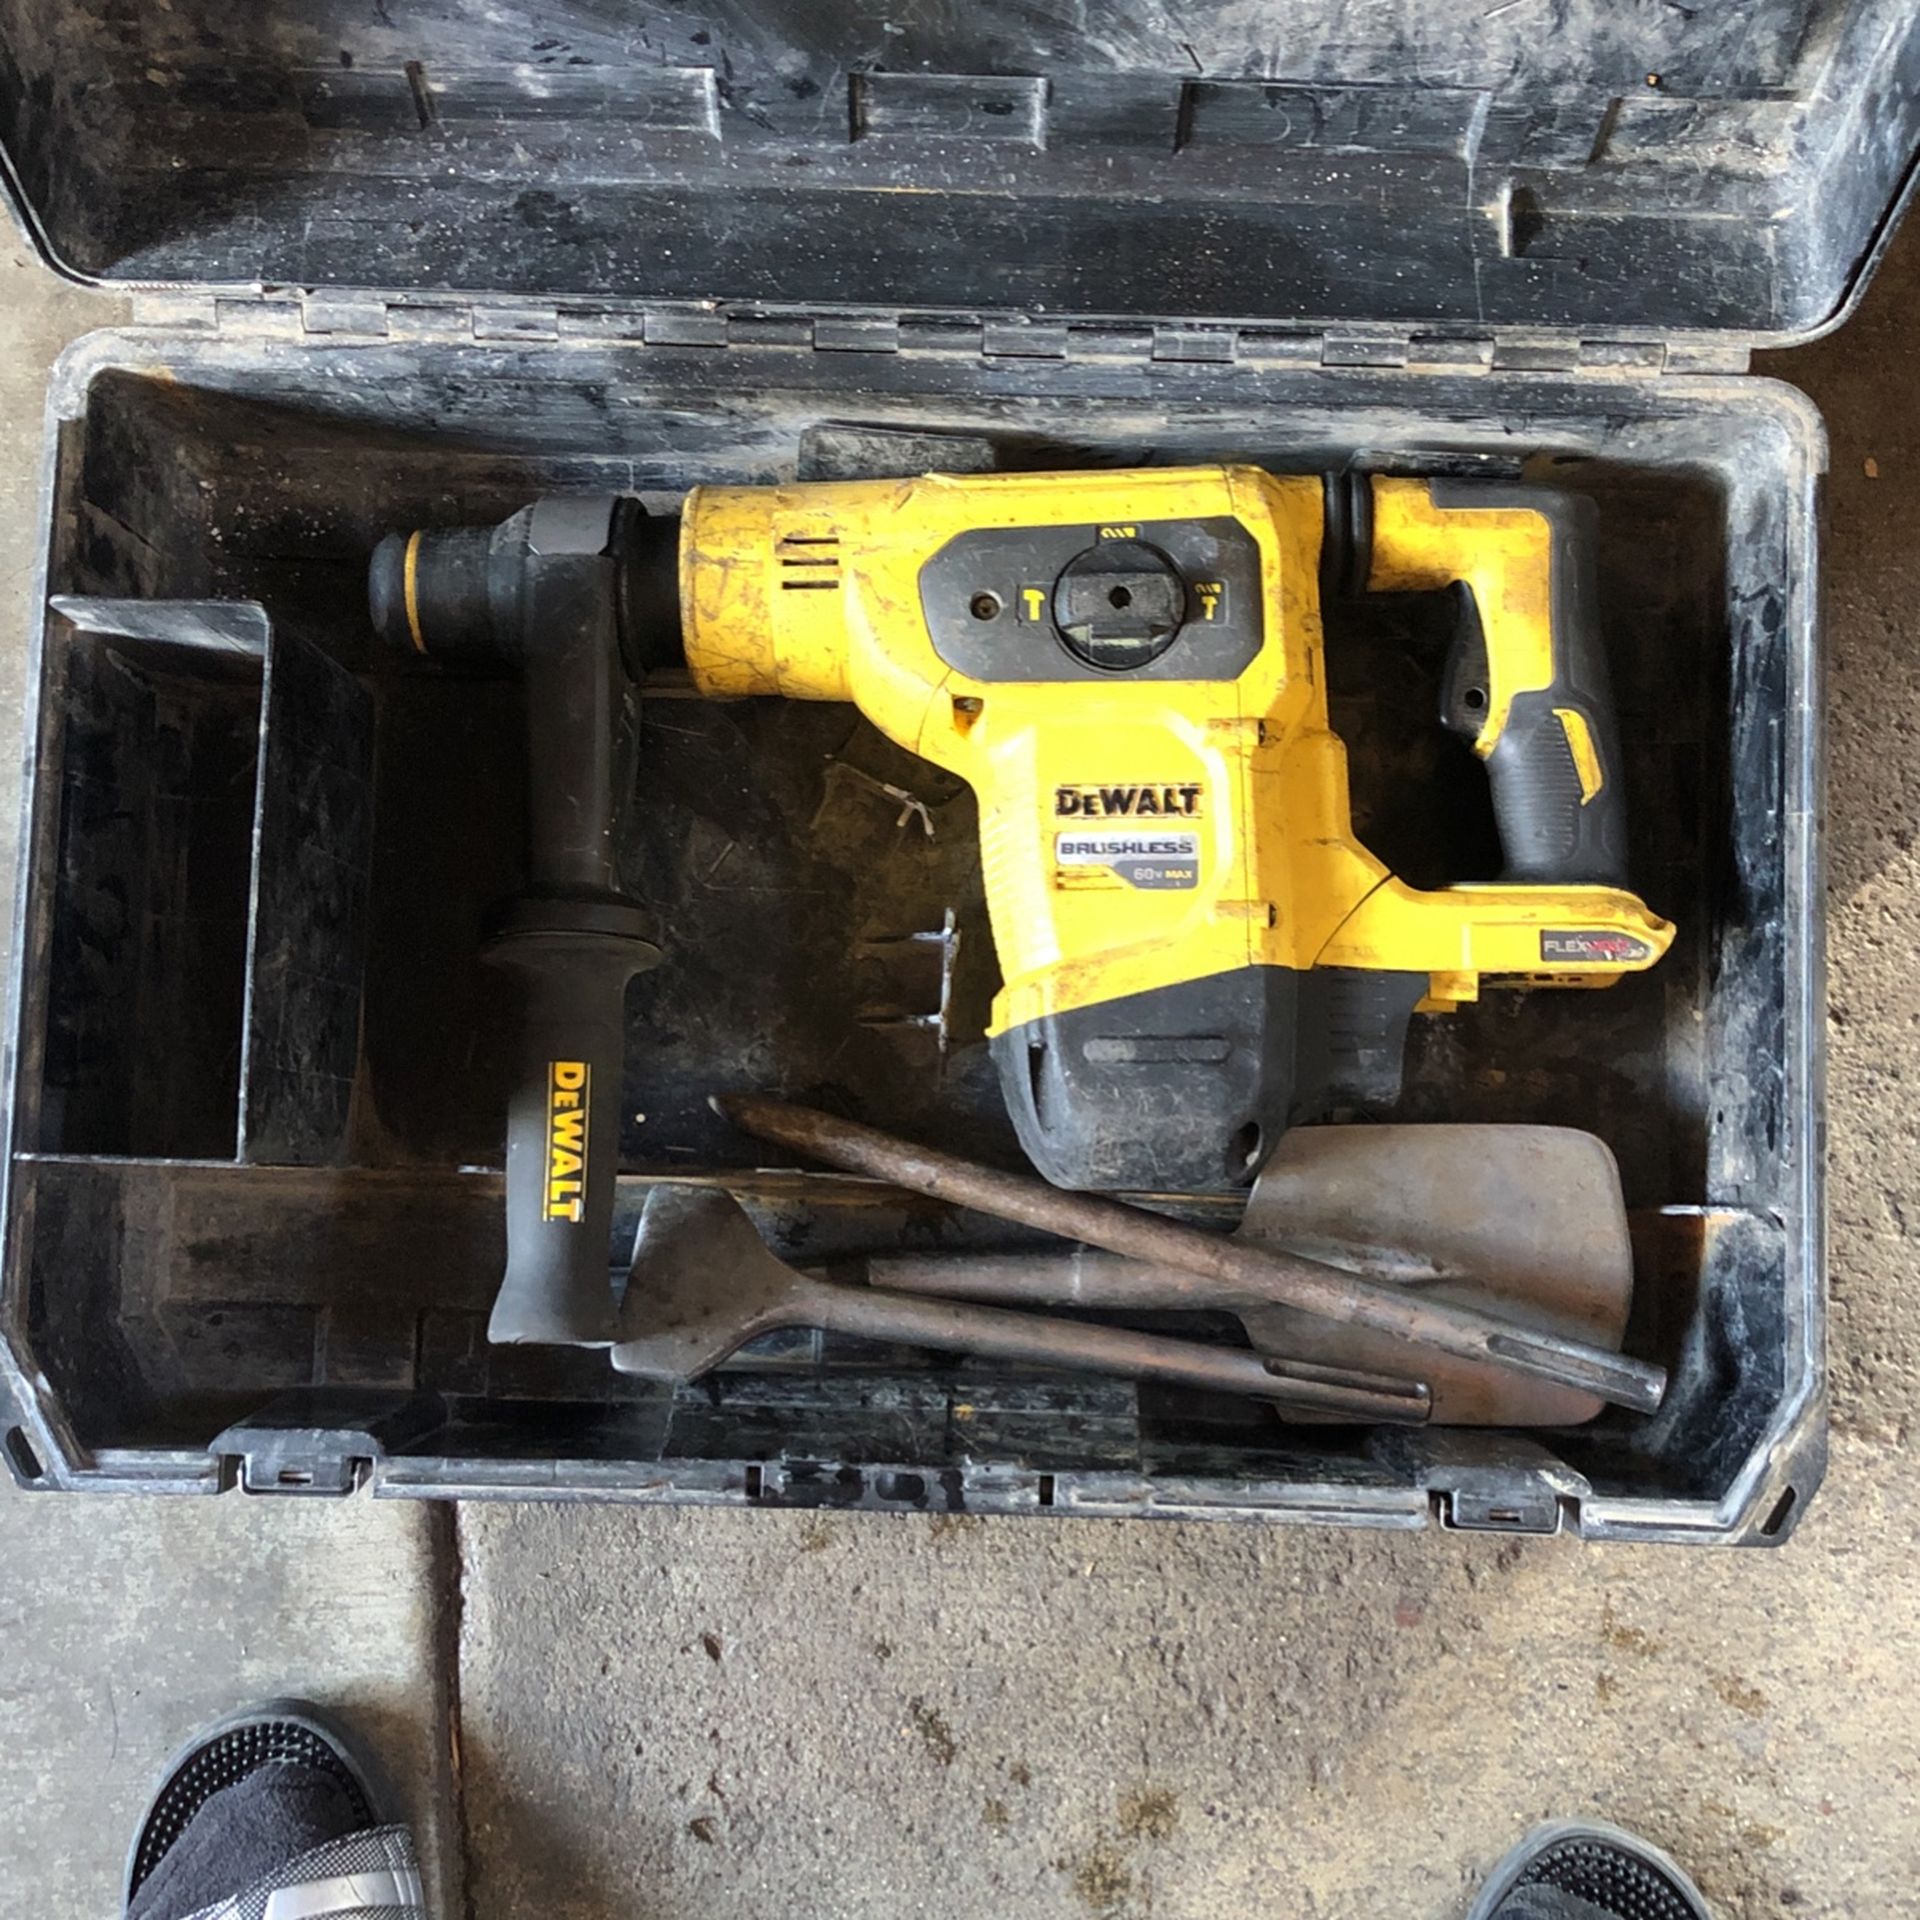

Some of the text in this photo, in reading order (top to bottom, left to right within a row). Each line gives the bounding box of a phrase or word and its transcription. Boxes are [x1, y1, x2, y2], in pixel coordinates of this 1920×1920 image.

[1055, 788, 1203, 816] DEWALT
[1060, 842, 1193, 855] BRUSHLESS
[1165, 869, 1193, 880] MAX
[550, 1061, 586, 1223] DEWALT
